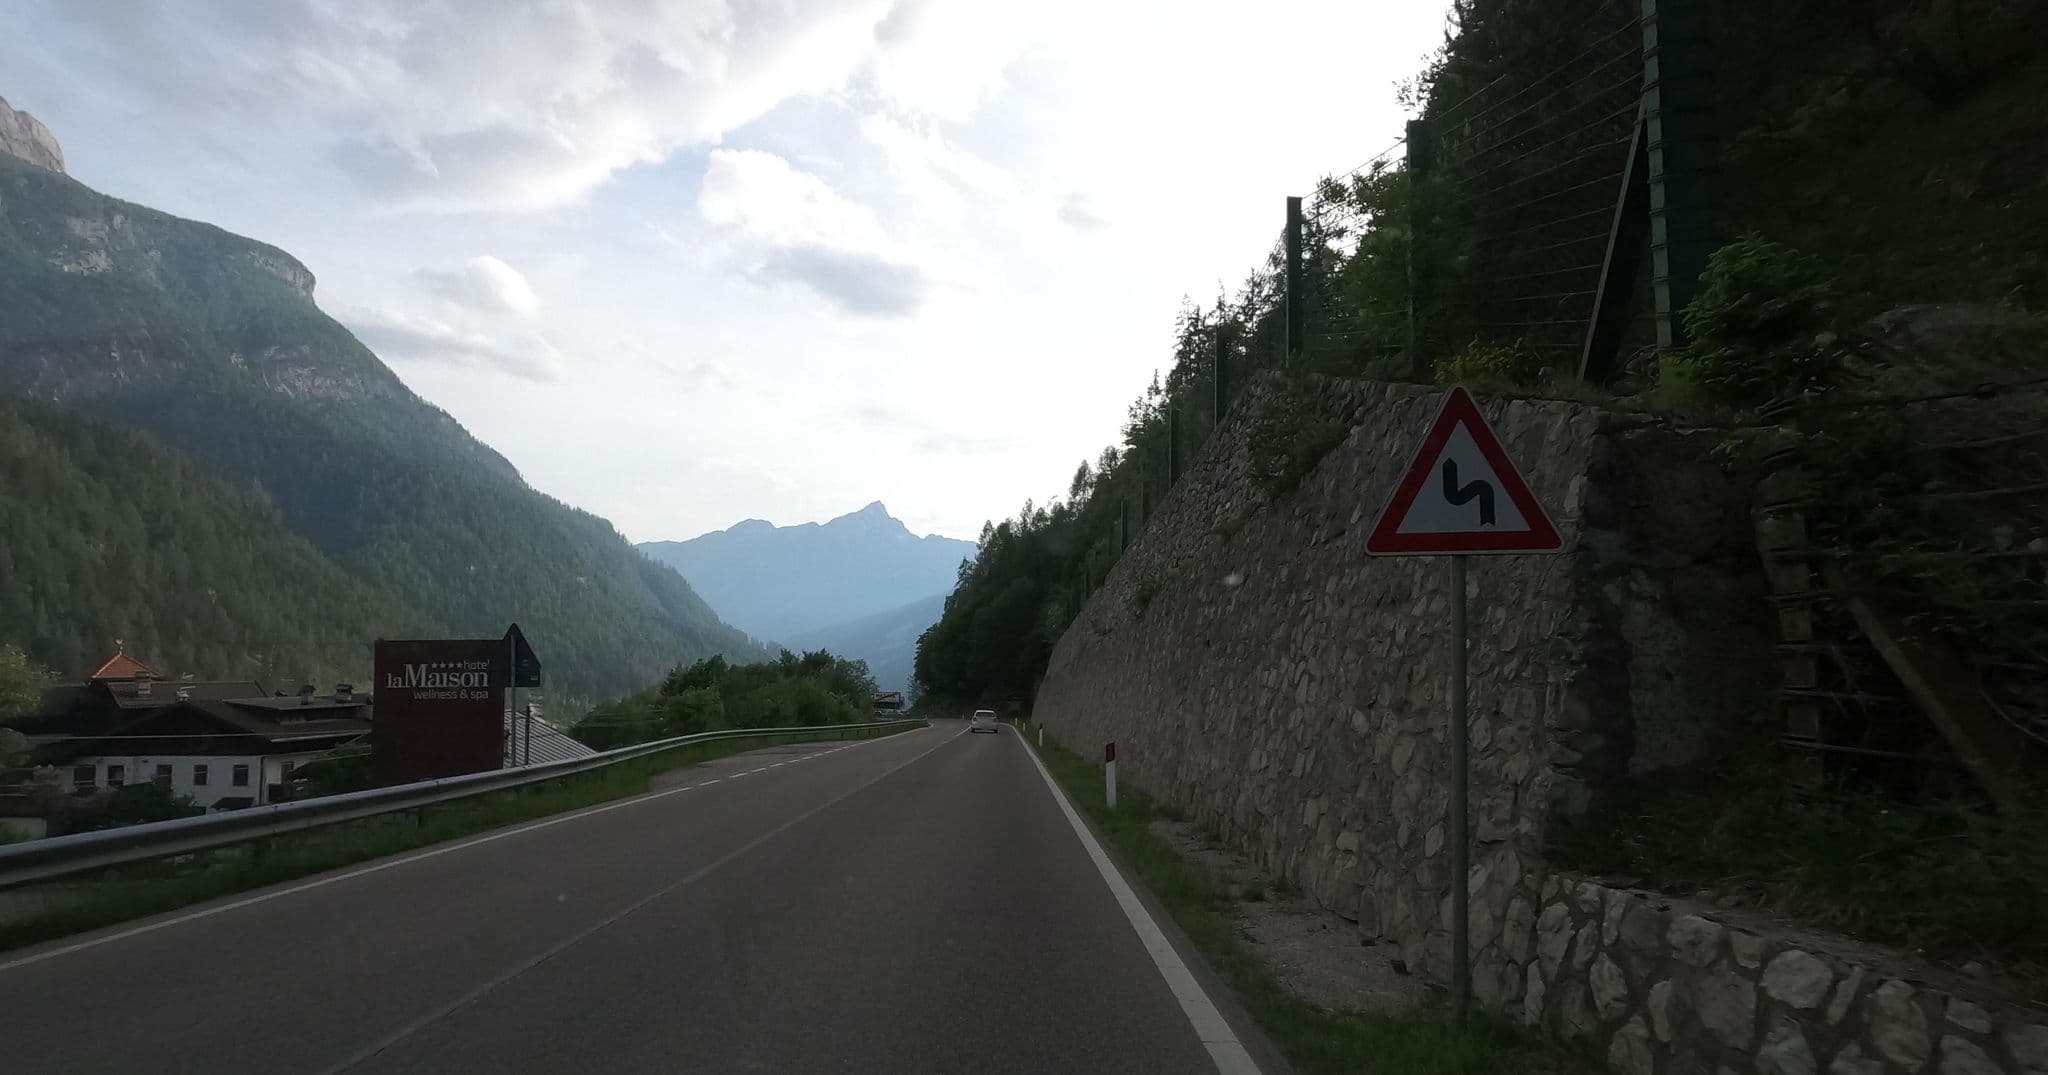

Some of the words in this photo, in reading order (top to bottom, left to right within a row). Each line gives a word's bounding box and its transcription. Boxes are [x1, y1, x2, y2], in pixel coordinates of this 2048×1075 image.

[413, 689, 458, 700] wellness
[460, 689, 468, 699] &
[470, 690, 489, 701] spa
